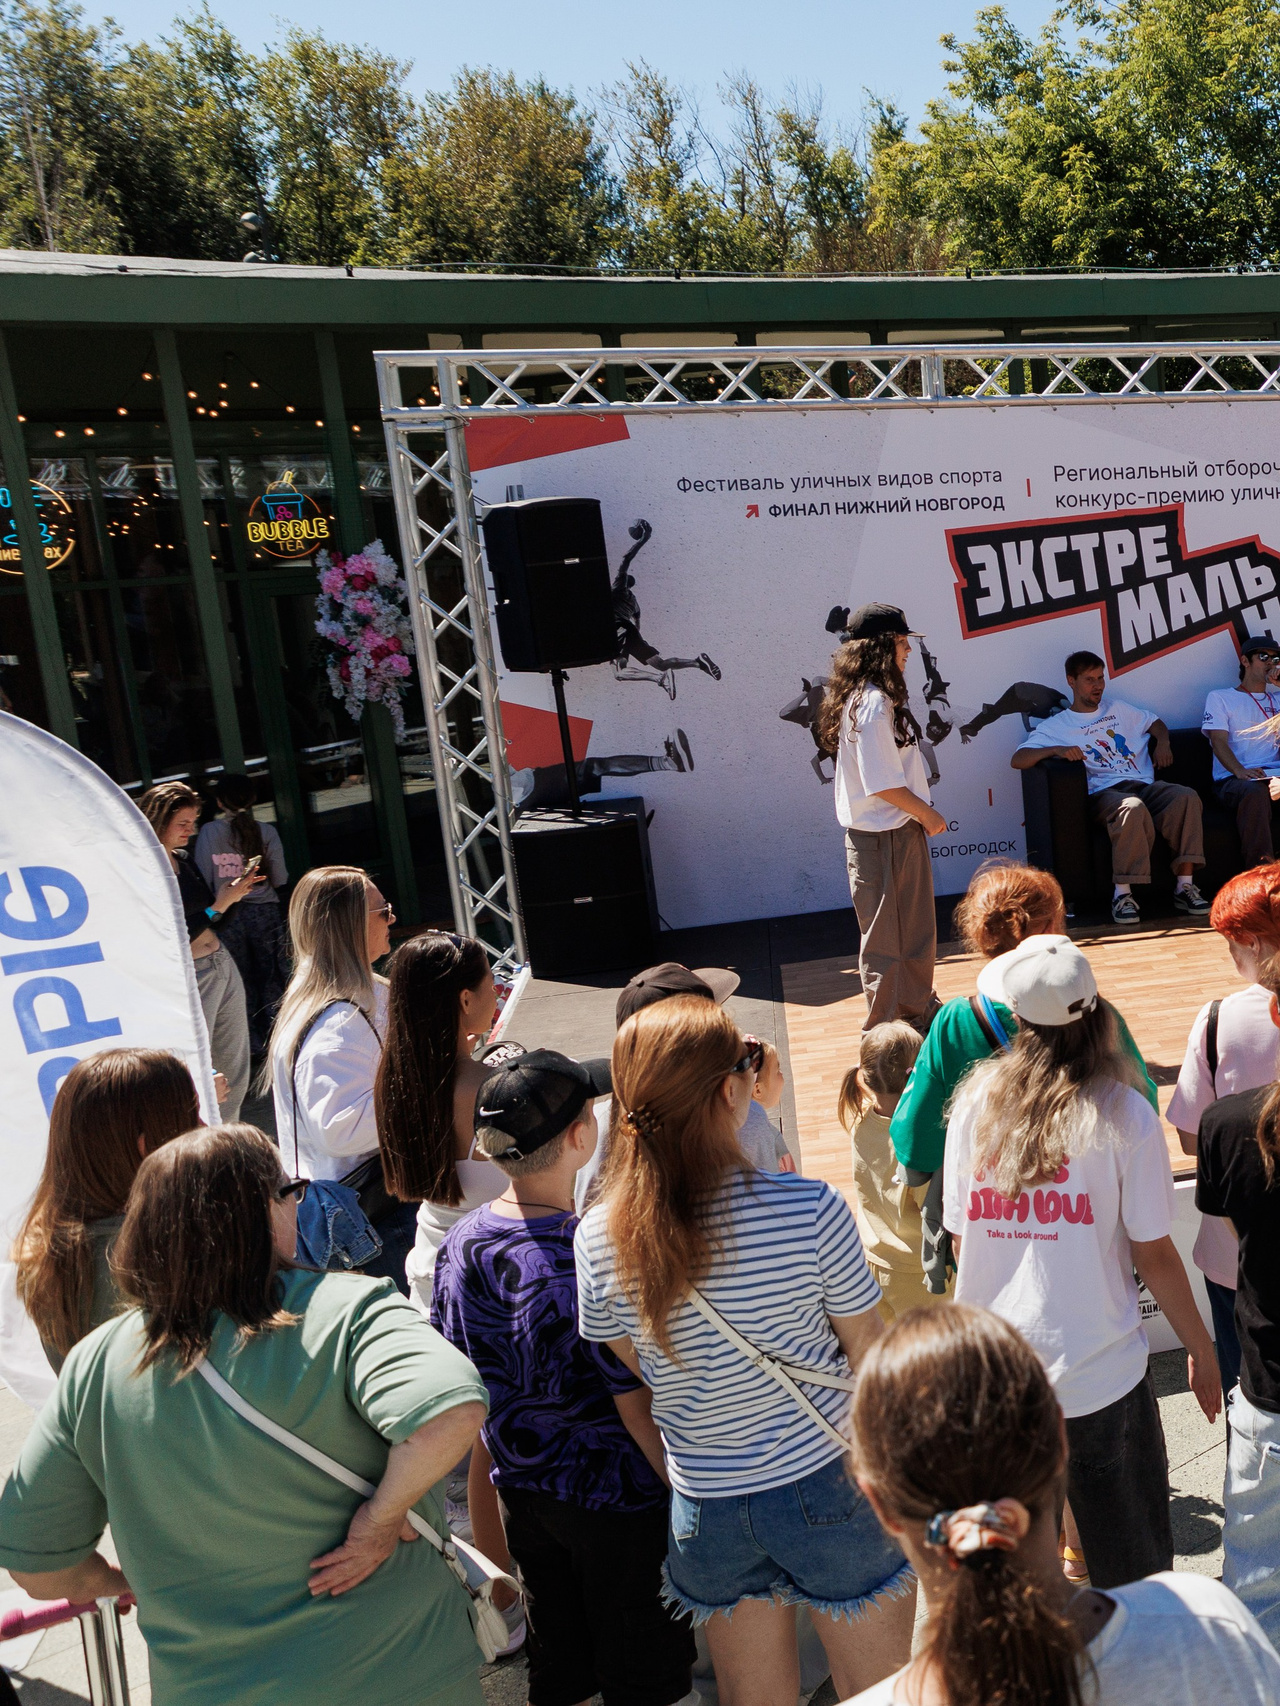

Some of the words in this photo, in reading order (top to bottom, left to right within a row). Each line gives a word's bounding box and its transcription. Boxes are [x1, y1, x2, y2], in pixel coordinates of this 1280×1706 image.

[676, 476, 785, 494] Фестиваль
[790, 474, 872, 493] уличных
[877, 471, 934, 489] видов
[939, 469, 1003, 487] спорта
[1053, 461, 1198, 482] Региональный
[768, 503, 831, 518] ФИНАЛ
[835, 497, 912, 516] НИЖНИЙ
[915, 495, 1005, 513] НОВГОРОД
[1055, 488, 1225, 510] конкурс-премию
[247, 517, 329, 542] BUBBLE
[275, 540, 305, 552] TEA
[967, 525, 1173, 617] ЭКСТРЕ
[1117, 556, 1277, 654] МАЛЬ
[930, 840, 1017, 859] БОГОРОДСК
[986, 1229, 1005, 1239] Take
[1014, 1230, 1032, 1240] look
[1033, 1231, 1059, 1241] around
